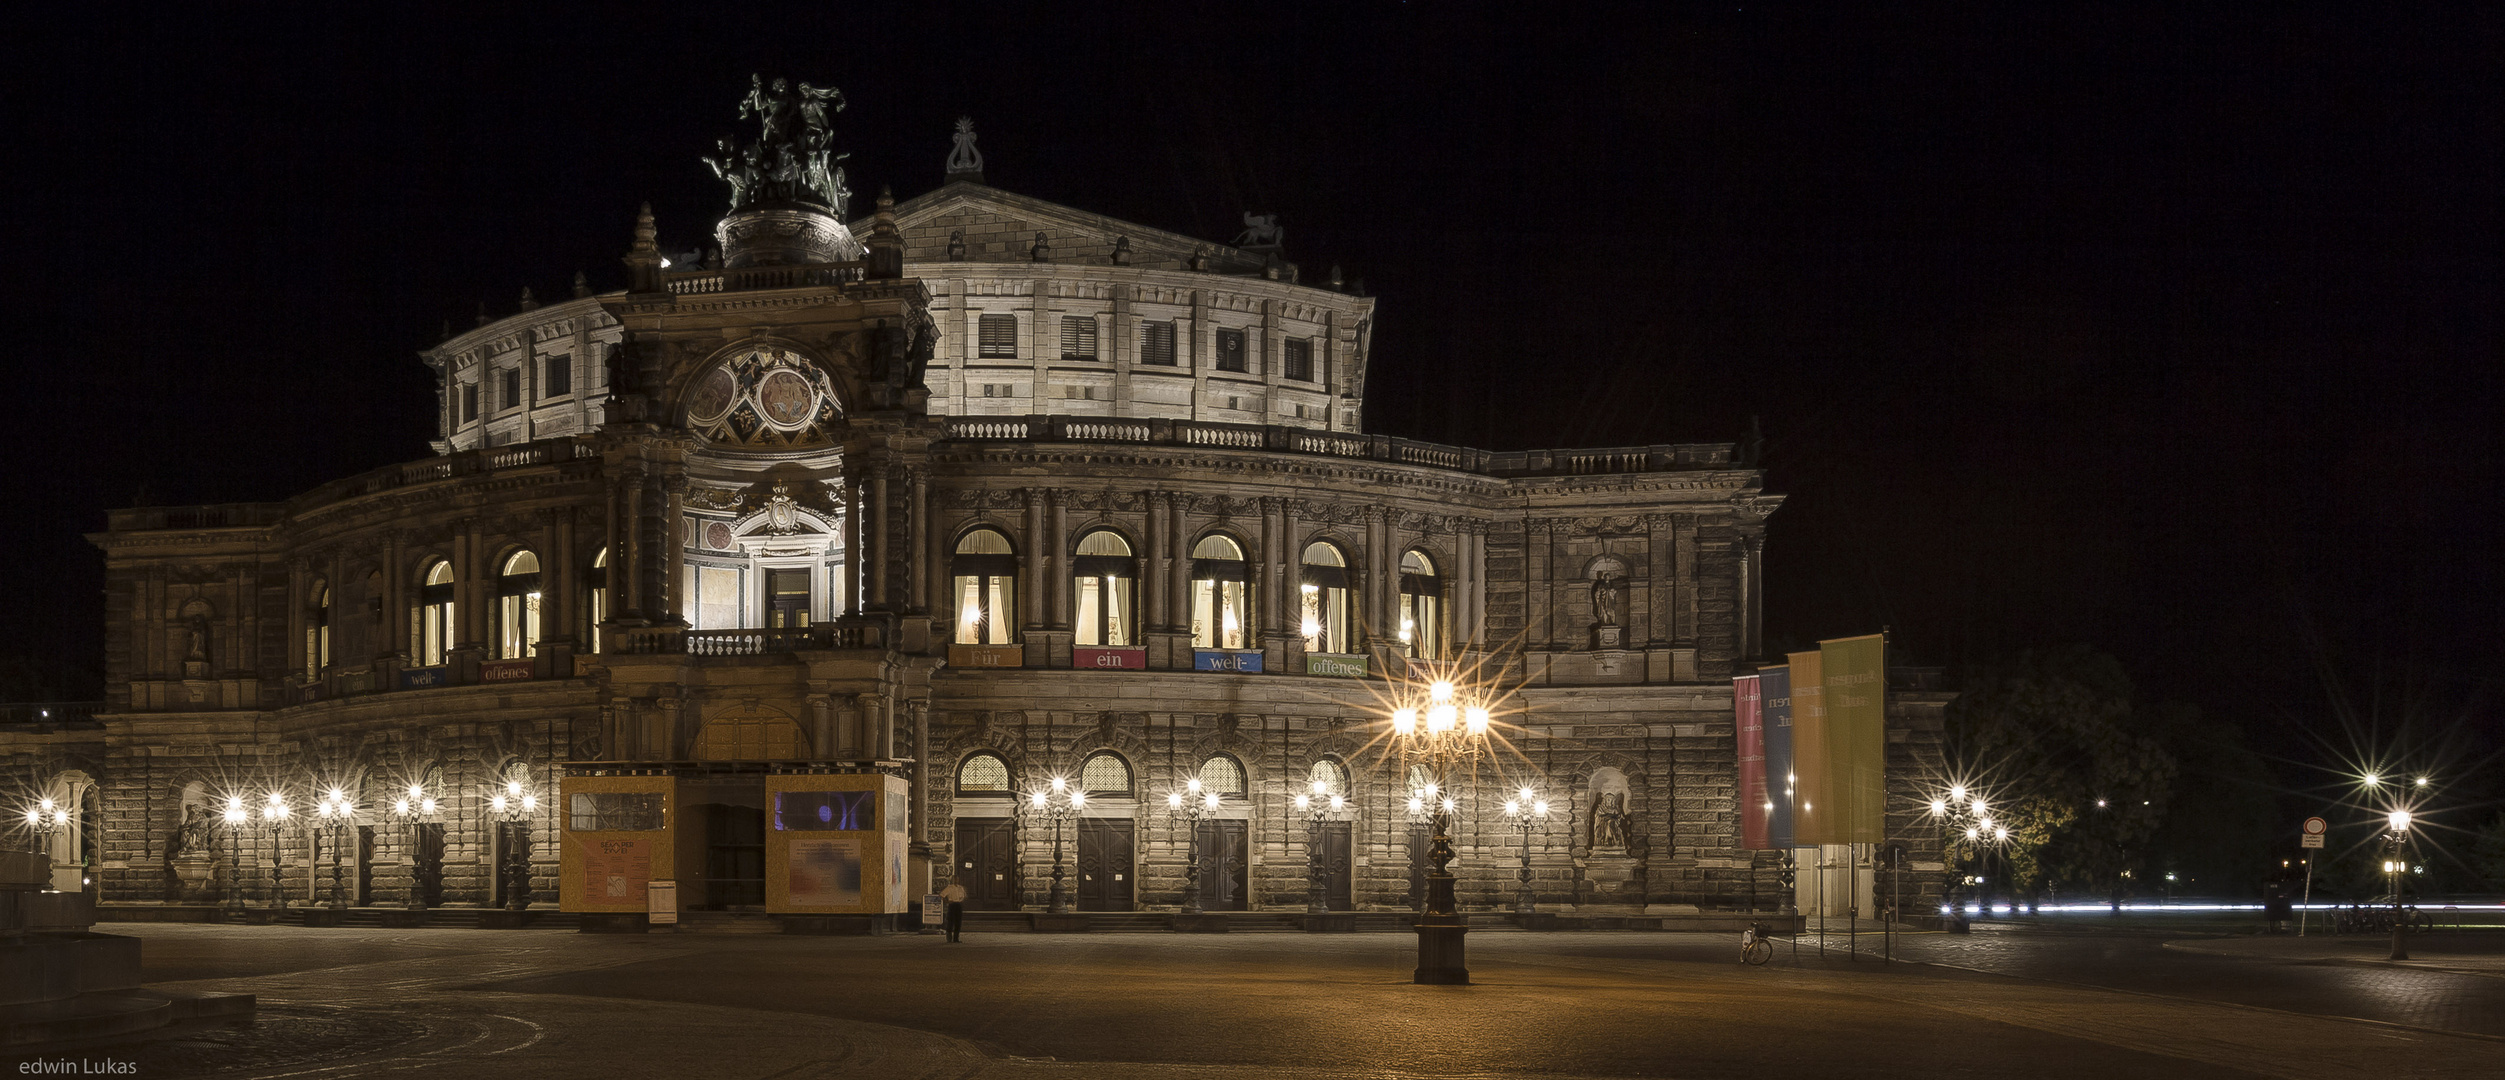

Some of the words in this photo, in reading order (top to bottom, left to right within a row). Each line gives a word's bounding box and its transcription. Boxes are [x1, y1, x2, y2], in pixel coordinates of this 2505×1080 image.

[971, 651, 1001, 666] Für
[1096, 651, 1123, 667] ein
[1209, 655, 1248, 670] welt-
[485, 662, 529, 680] offenes
[1312, 659, 1363, 676] offenes
[352, 679, 365, 691] ein
[411, 671, 437, 686] welt-
[304, 687, 316, 701] Für
